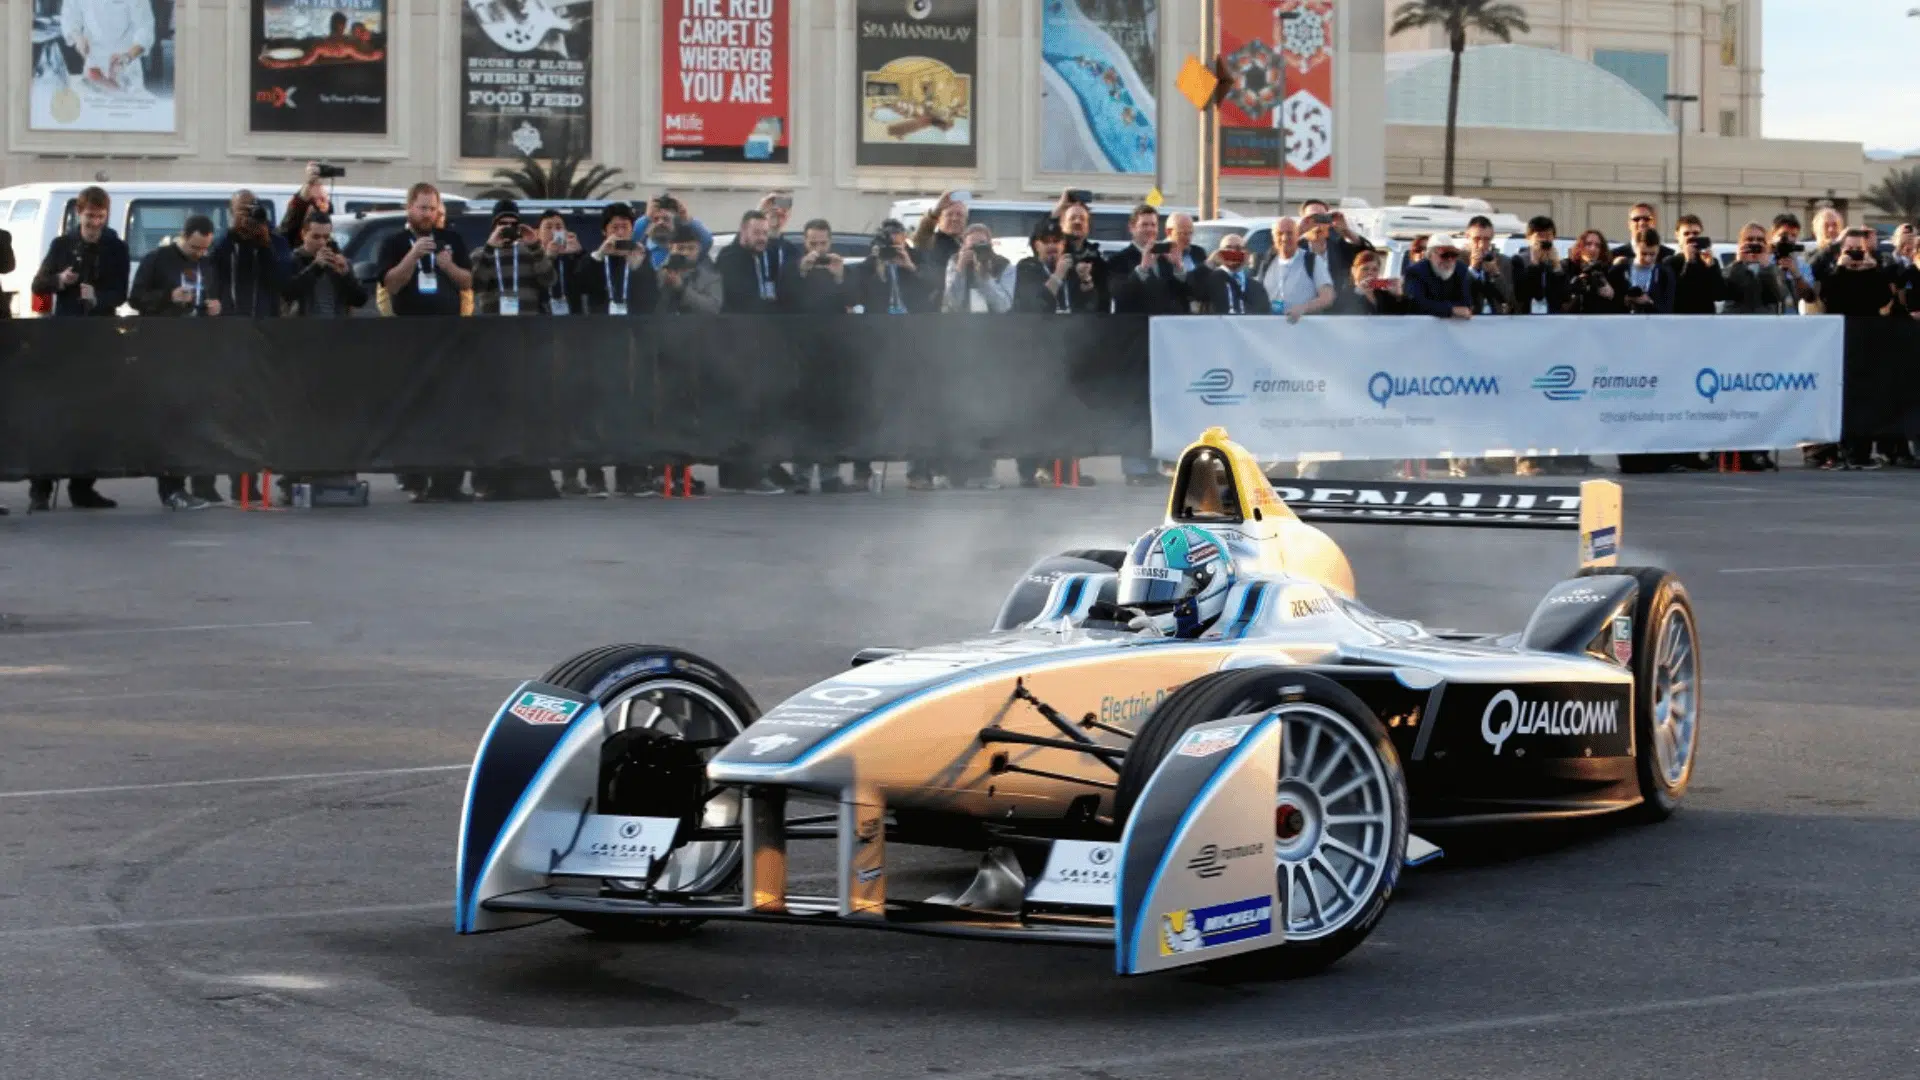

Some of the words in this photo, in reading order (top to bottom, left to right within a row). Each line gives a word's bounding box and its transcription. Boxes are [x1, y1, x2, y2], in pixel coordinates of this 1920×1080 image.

[682, 0, 721, 16] THE
[729, 0, 772, 18] RED
[679, 19, 749, 45] CARPET
[755, 21, 772, 46] IS
[469, 58, 514, 68] HOUSE
[518, 59, 536, 69] OF
[540, 60, 583, 70] BLUES
[681, 45, 772, 71] WHEREVER
[468, 72, 529, 84] WHERE
[535, 74, 584, 86] MUSIC
[681, 71, 723, 102] YOU
[729, 73, 772, 104] ARE
[468, 91, 523, 105] FOOD
[530, 93, 583, 107] FEED
[1366, 371, 1500, 408] QUALCOMM
[1695, 368, 1817, 403] QUALCOMM
[1101, 691, 1151, 722] Electric
[1481, 689, 1618, 756] QUALCOMM
[1202, 906, 1272, 932] MICHELIN
